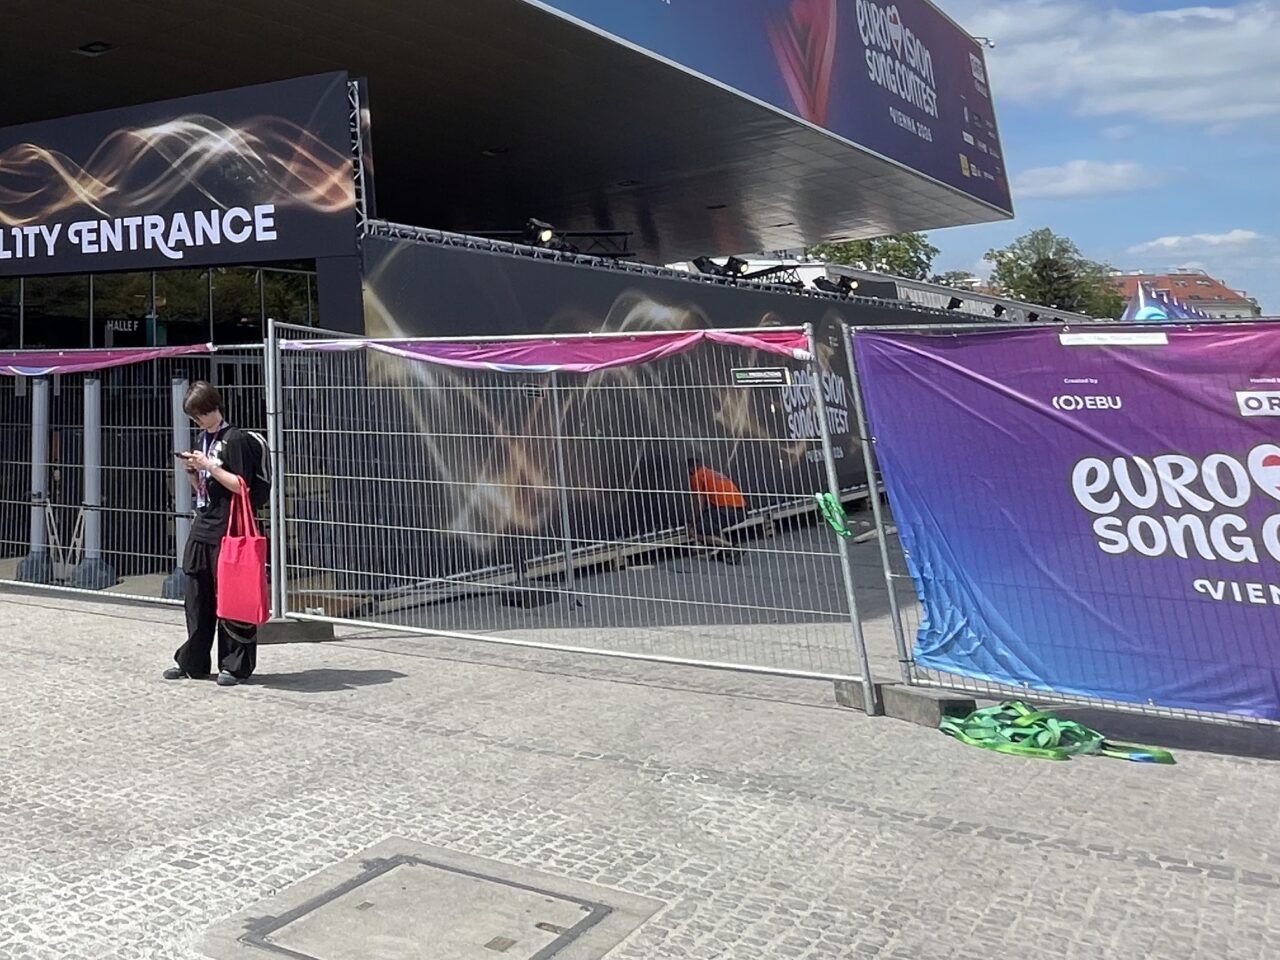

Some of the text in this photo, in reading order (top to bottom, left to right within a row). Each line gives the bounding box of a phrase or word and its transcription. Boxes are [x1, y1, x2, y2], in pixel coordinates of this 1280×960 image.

[865, 48, 898, 95] SONG
[894, 59, 939, 120] CONTEST
[68, 204, 278, 260] ENTRANCE
[106, 319, 139, 332] HALLE F
[1084, 395, 1122, 409] EBU
[1092, 513, 1260, 564] SONG
